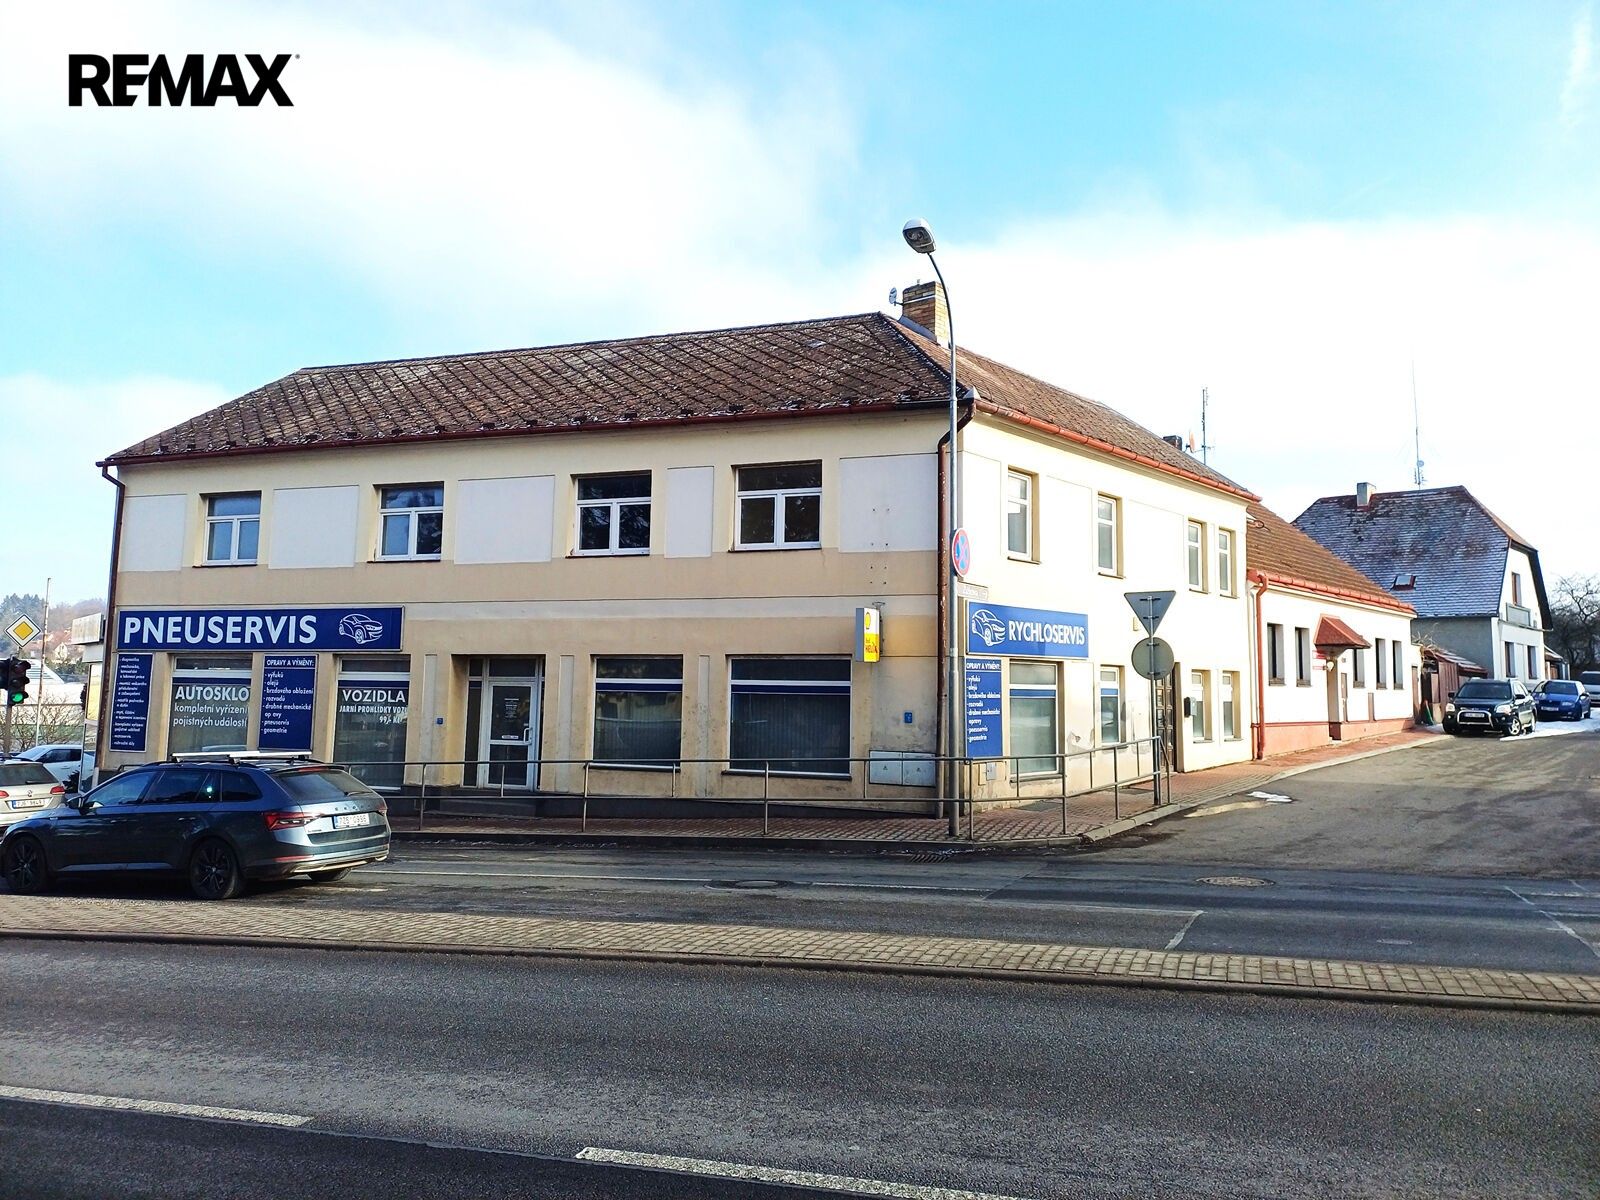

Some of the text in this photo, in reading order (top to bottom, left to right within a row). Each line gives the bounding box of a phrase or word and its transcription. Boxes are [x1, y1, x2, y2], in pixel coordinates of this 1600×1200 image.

[124, 615, 317, 644] PNEUSERVIS
[1008, 620, 1085, 645] RYCHLOSERVIS
[175, 686, 250, 702] AUTOSKLO
[342, 689, 406, 703] VOZIDLA
[174, 703, 214, 714] kompletní
[339, 703, 357, 713] JARNÍ
[173, 716, 248, 728] pojistných událostí
